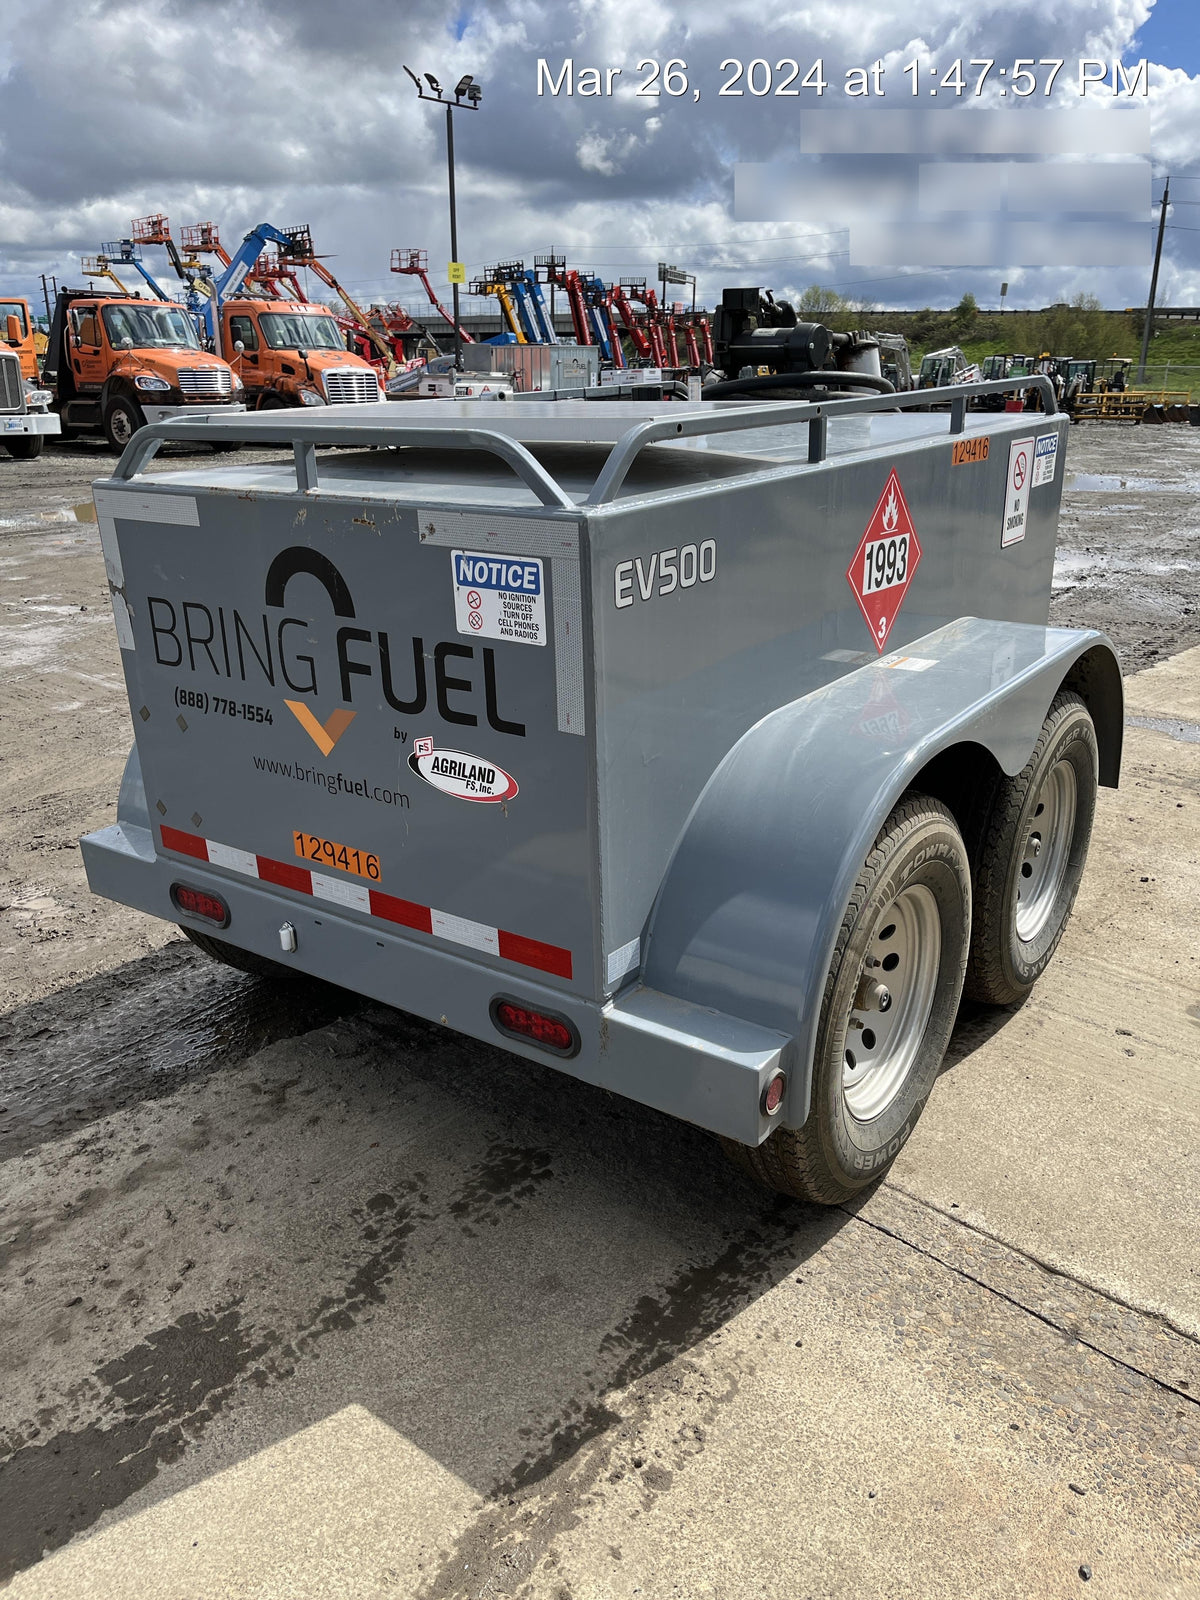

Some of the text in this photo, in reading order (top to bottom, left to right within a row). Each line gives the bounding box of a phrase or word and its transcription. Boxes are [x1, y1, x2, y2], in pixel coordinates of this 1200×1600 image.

[953, 437, 989, 464] 129416
[1036, 436, 1057, 456] NOTICE
[1007, 512, 1024, 531] SMOKING
[614, 537, 717, 610] EV500
[866, 536, 908, 590] 1993
[459, 559, 537, 590] NOTICE
[498, 591, 537, 604] NO IGNITION
[502, 601, 533, 613] SOURCES
[498, 618, 540, 631] CELL PHONES
[503, 610, 533, 621] TURN OFF
[500, 627, 538, 640] AND RADIOS
[878, 616, 887, 638] 3
[147, 596, 526, 738] BRING FUEL
[174, 685, 274, 726] (888) 778-1554
[394, 726, 408, 743] by
[418, 742, 430, 753] FS
[431, 756, 497, 785] AGRILAND
[252, 755, 411, 809] www.bringfuel.com
[465, 780, 495, 796] FS, Inc.
[296, 833, 380, 880] 129416
[853, 1121, 912, 1171] POWER
